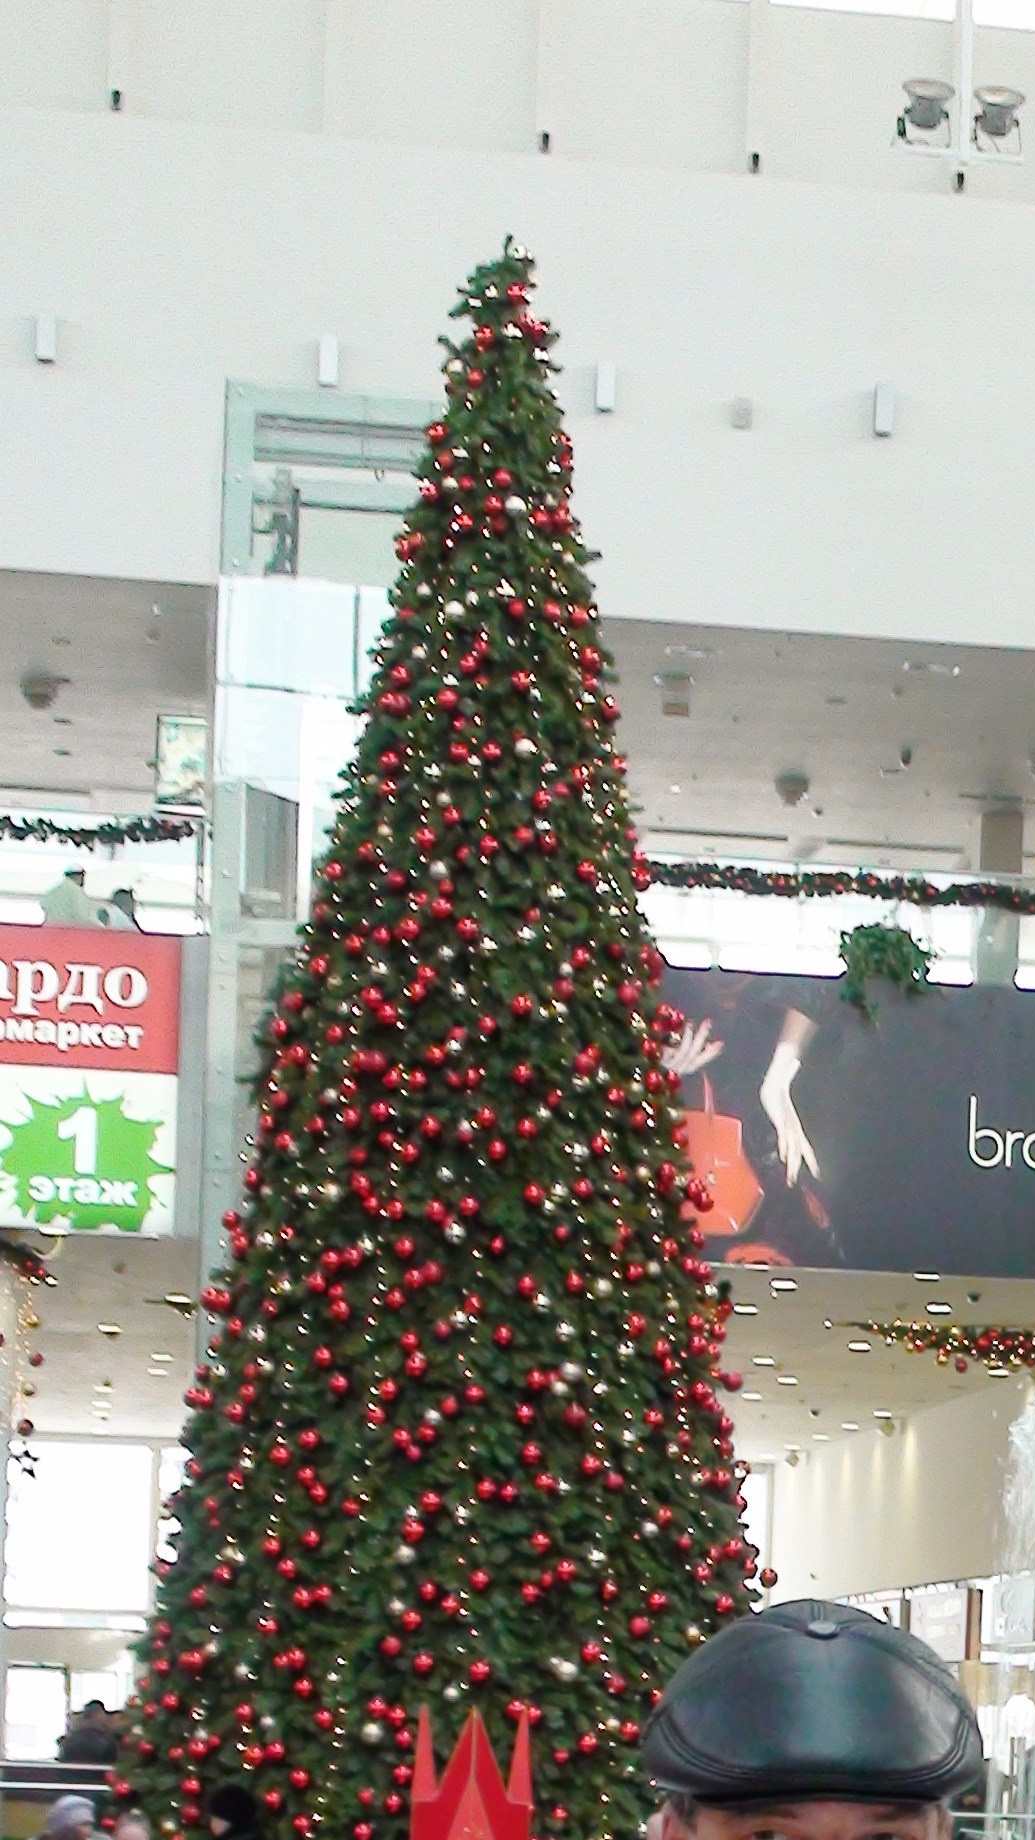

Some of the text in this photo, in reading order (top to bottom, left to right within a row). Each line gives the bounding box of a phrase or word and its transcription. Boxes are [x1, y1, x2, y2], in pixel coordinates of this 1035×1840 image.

[0, 1016, 145, 1052] маркет
[57, 1106, 98, 1176] 1
[28, 1175, 139, 1208] этаж
